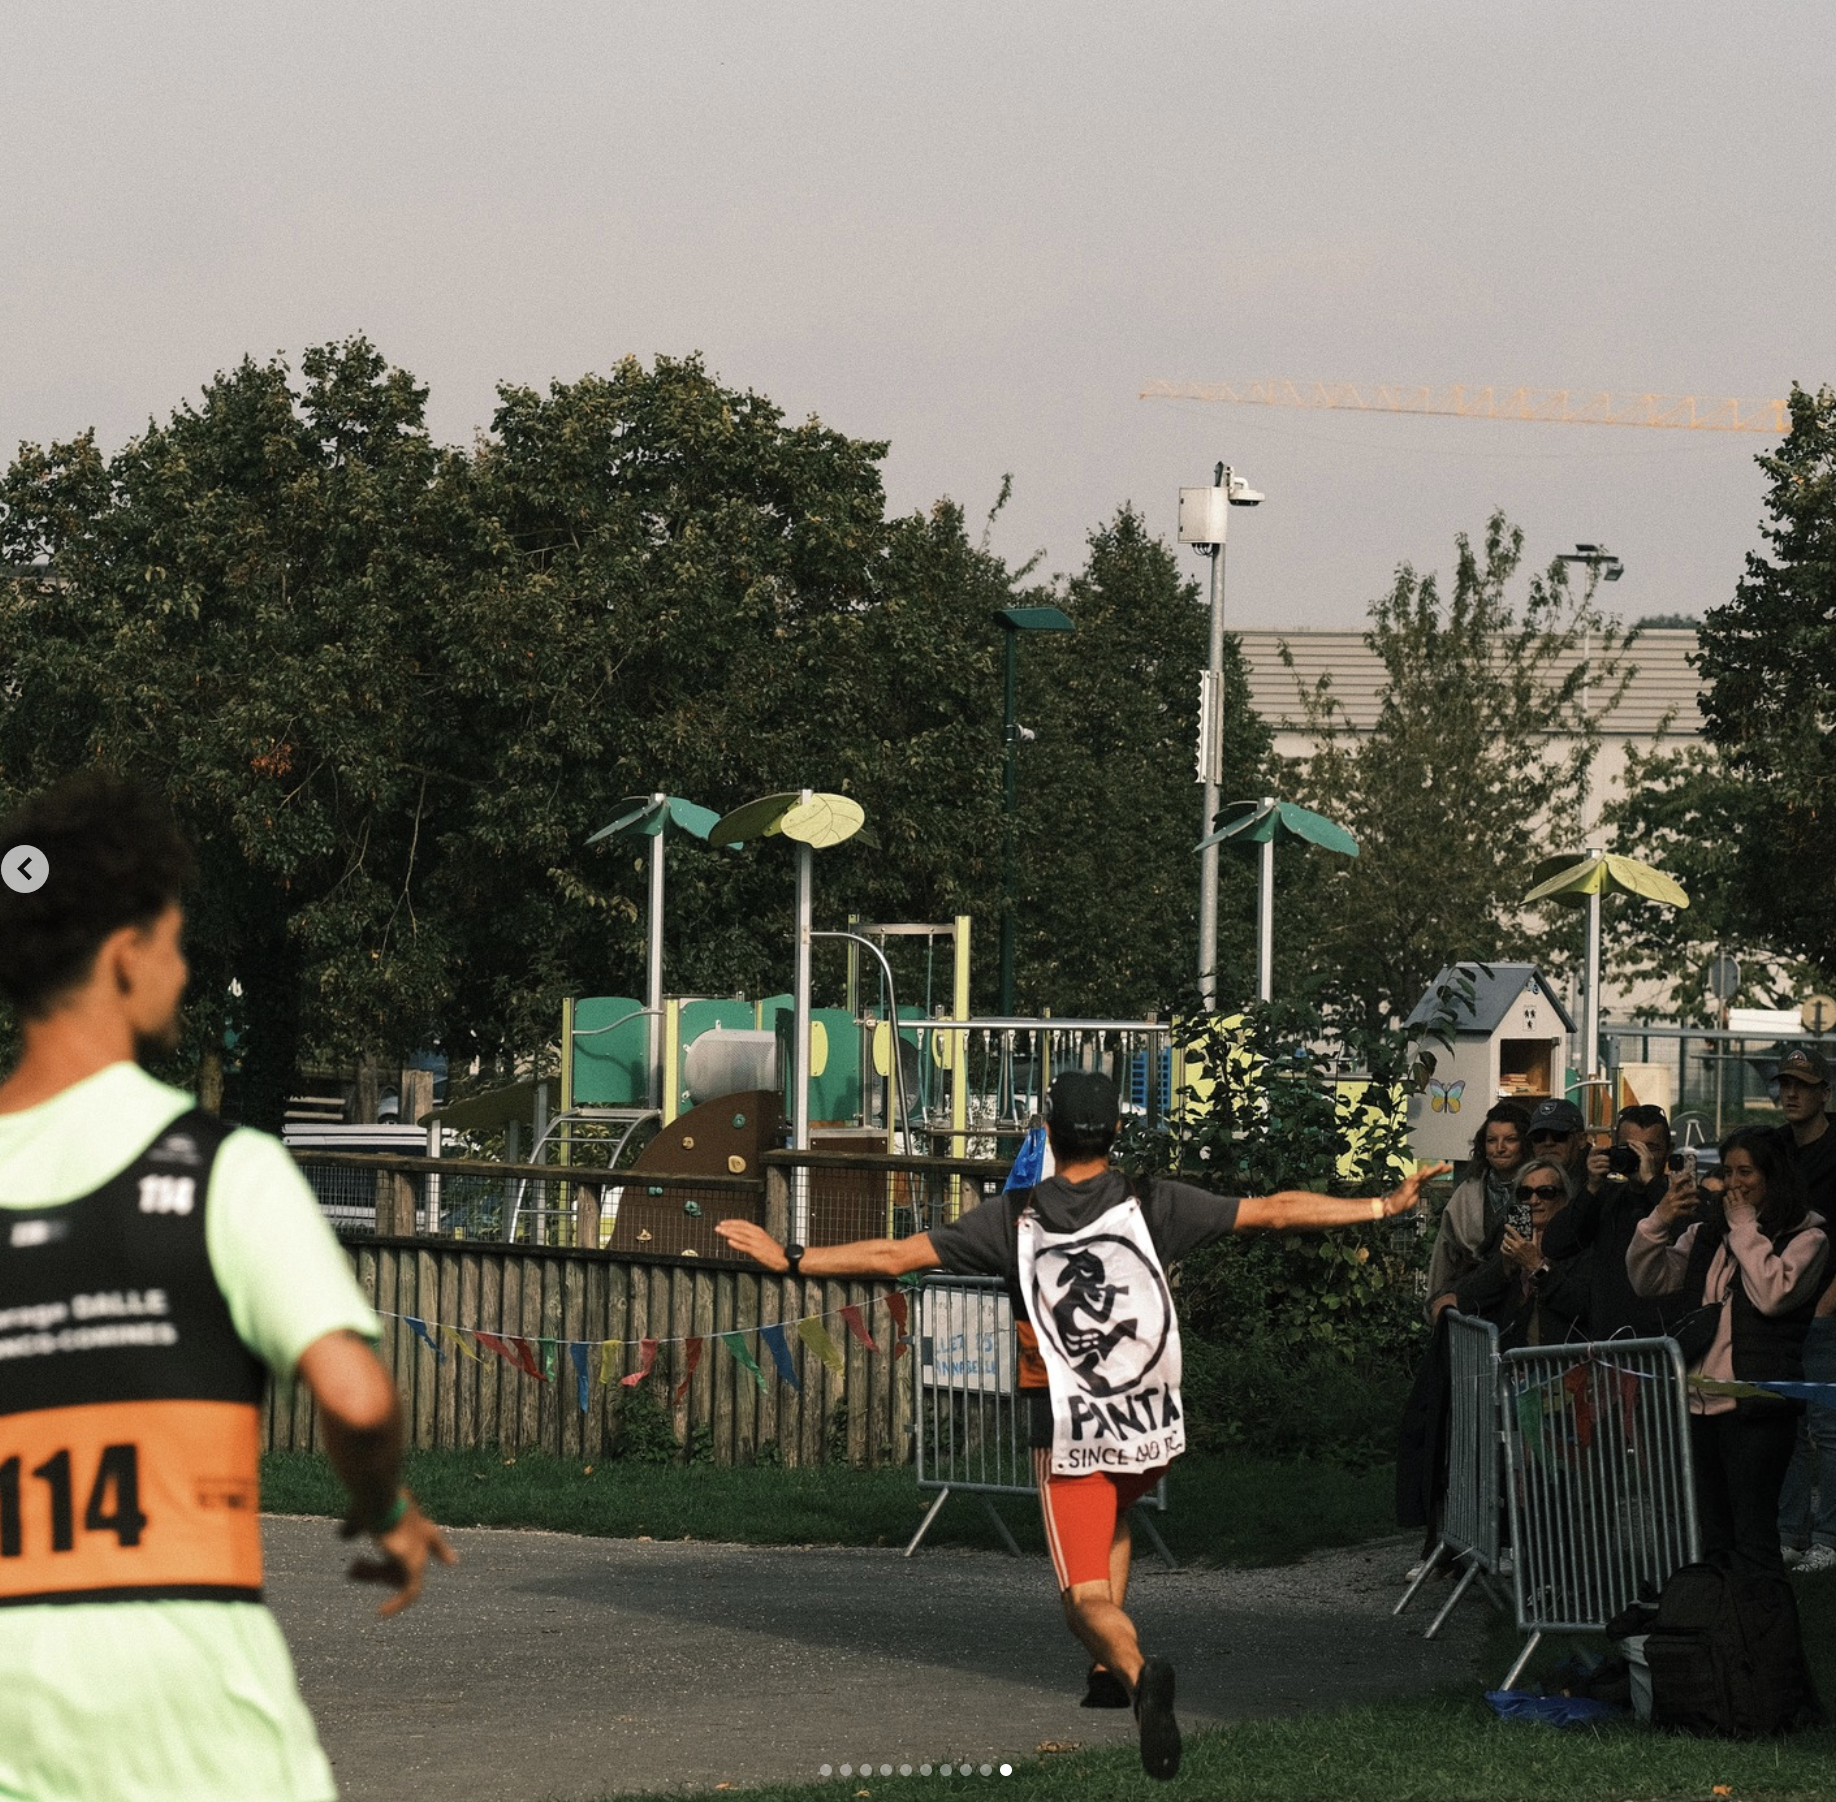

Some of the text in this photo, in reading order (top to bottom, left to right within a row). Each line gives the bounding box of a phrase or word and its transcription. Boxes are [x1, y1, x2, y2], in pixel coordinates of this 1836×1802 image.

[1067, 1382, 1181, 1441] PANTA
[1068, 1446, 1129, 1468] SINCE
[0, 1444, 147, 1557] 114
